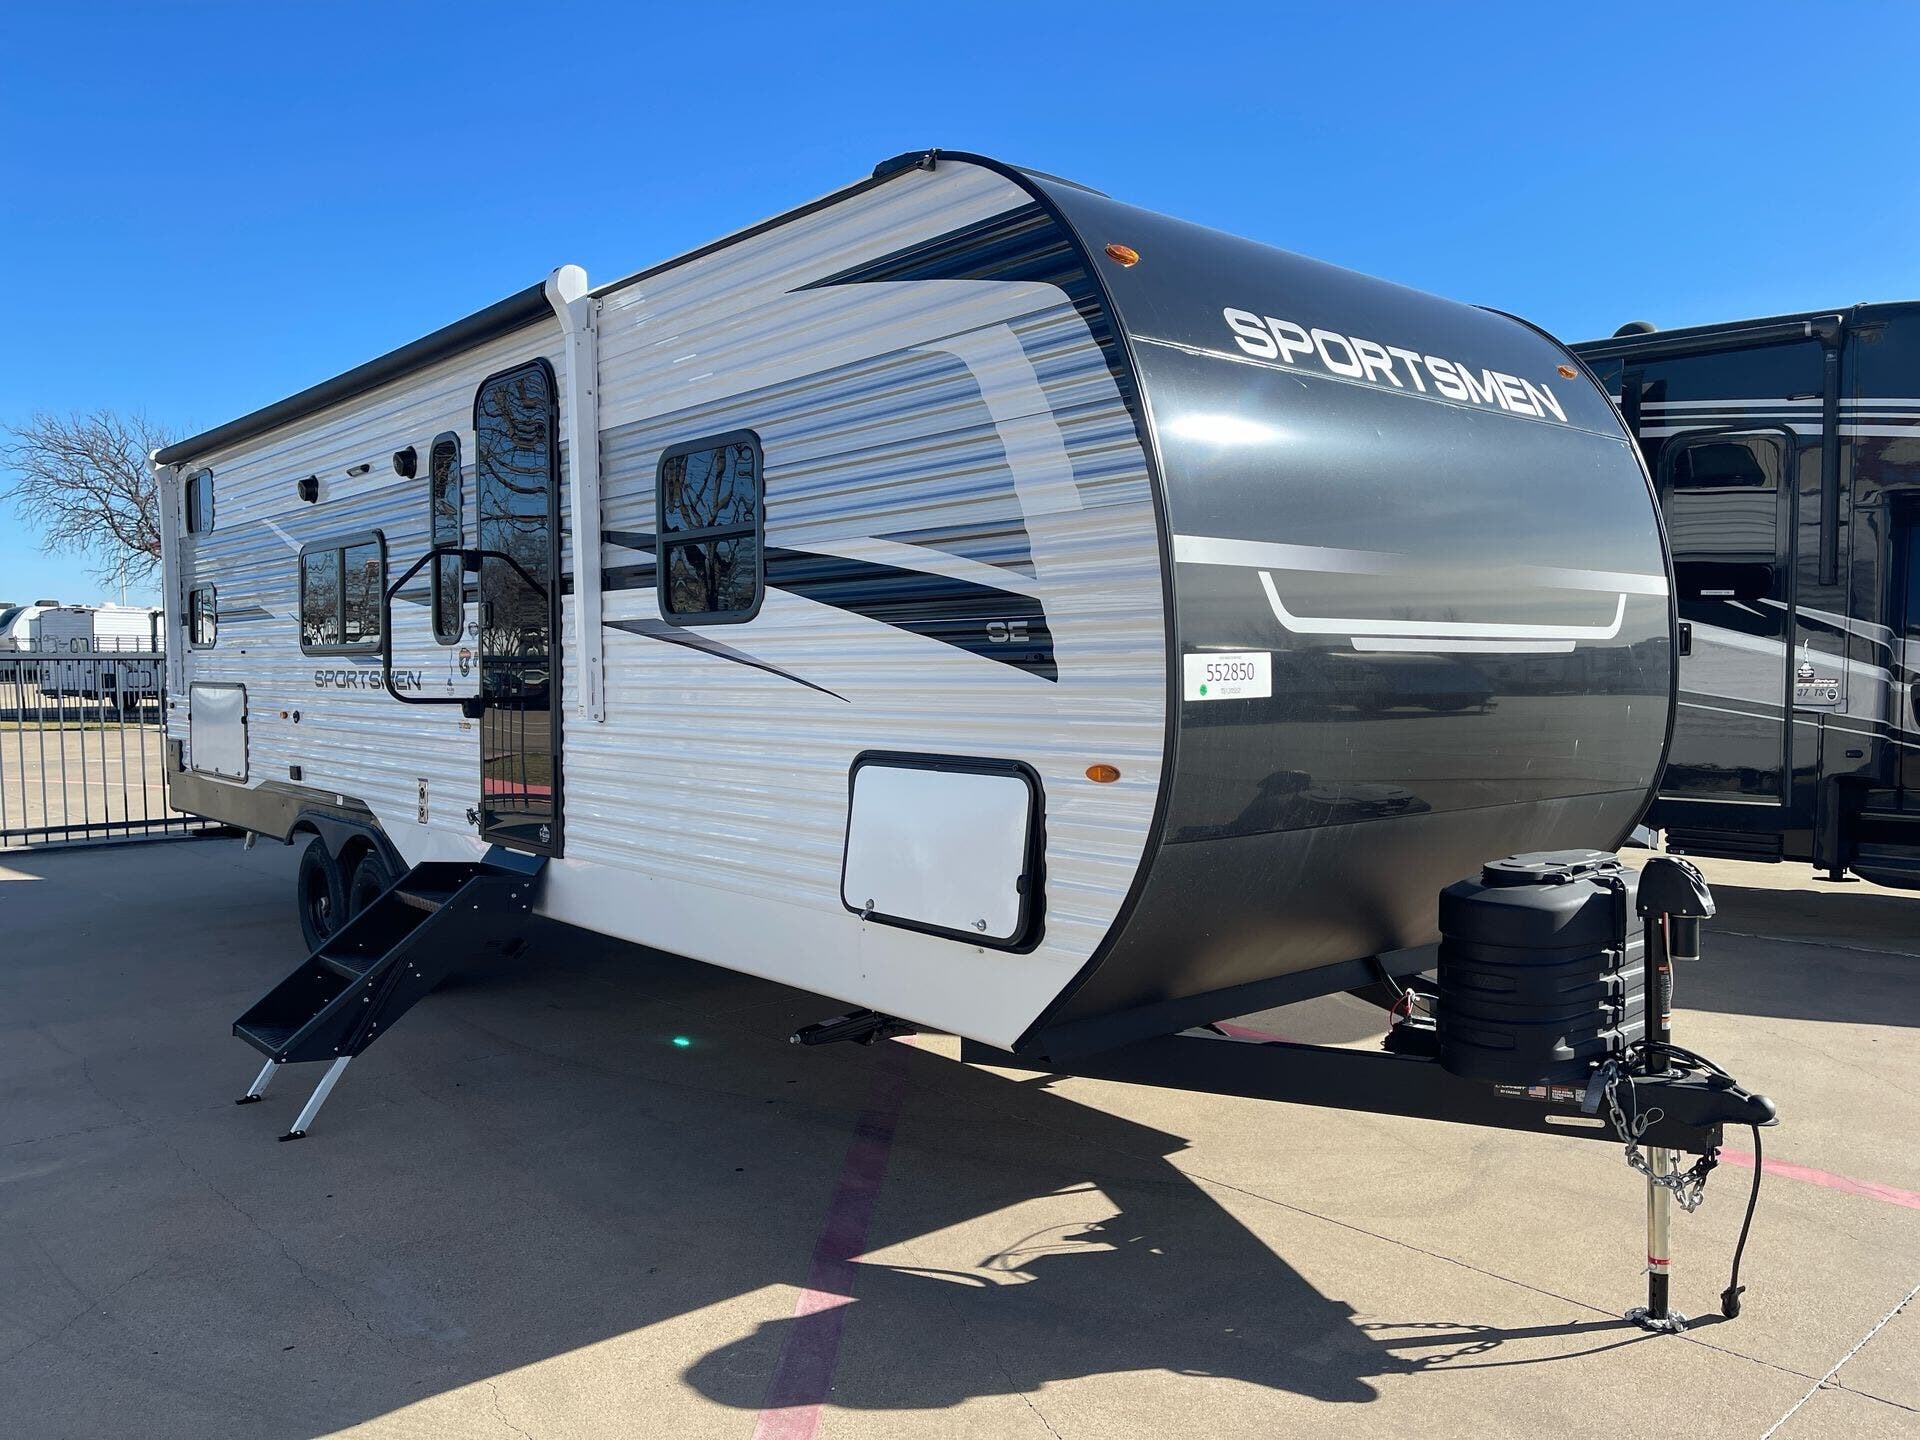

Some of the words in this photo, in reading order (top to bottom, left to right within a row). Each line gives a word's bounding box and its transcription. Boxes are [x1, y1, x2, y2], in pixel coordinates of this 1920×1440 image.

[1222, 306, 1568, 422] SPORTSMEN
[985, 621, 1030, 643] SE
[1206, 662, 1255, 682] 552850
